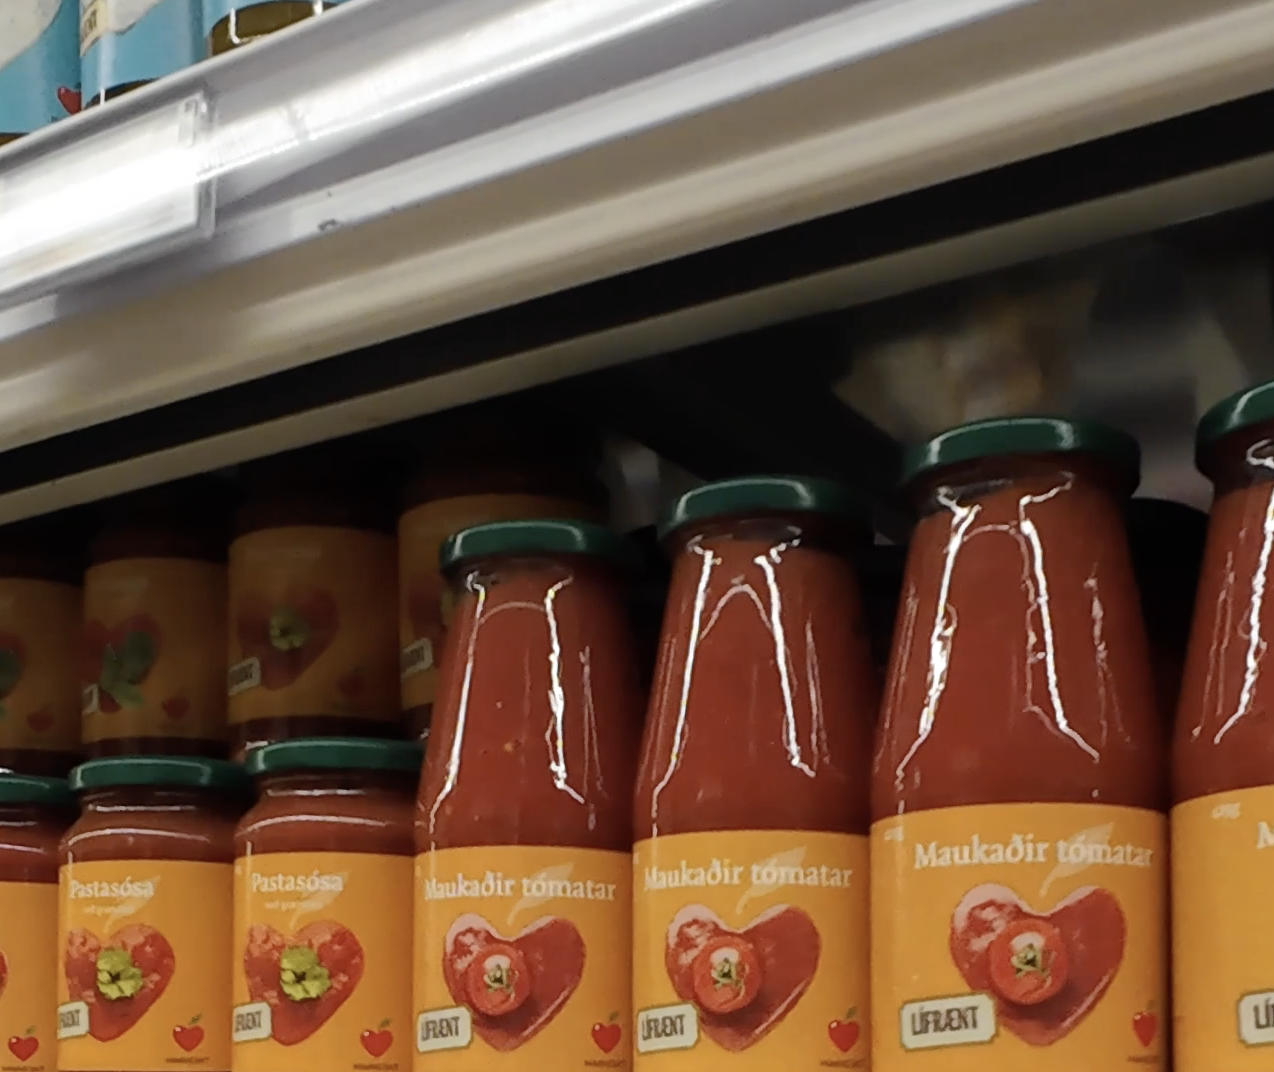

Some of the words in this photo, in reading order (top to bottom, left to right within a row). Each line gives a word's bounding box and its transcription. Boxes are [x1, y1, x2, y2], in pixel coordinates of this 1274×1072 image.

[913, 833, 1050, 869] Maukaðir
[69, 876, 154, 900] Pastasósa
[252, 871, 344, 894] Pastasósa
[425, 869, 513, 900] Maukaðir
[522, 871, 617, 902] tómatar
[644, 859, 743, 892] Maukaðir
[751, 855, 852, 888] tómatar
[910, 1004, 979, 1036] LÍFRÆNT
